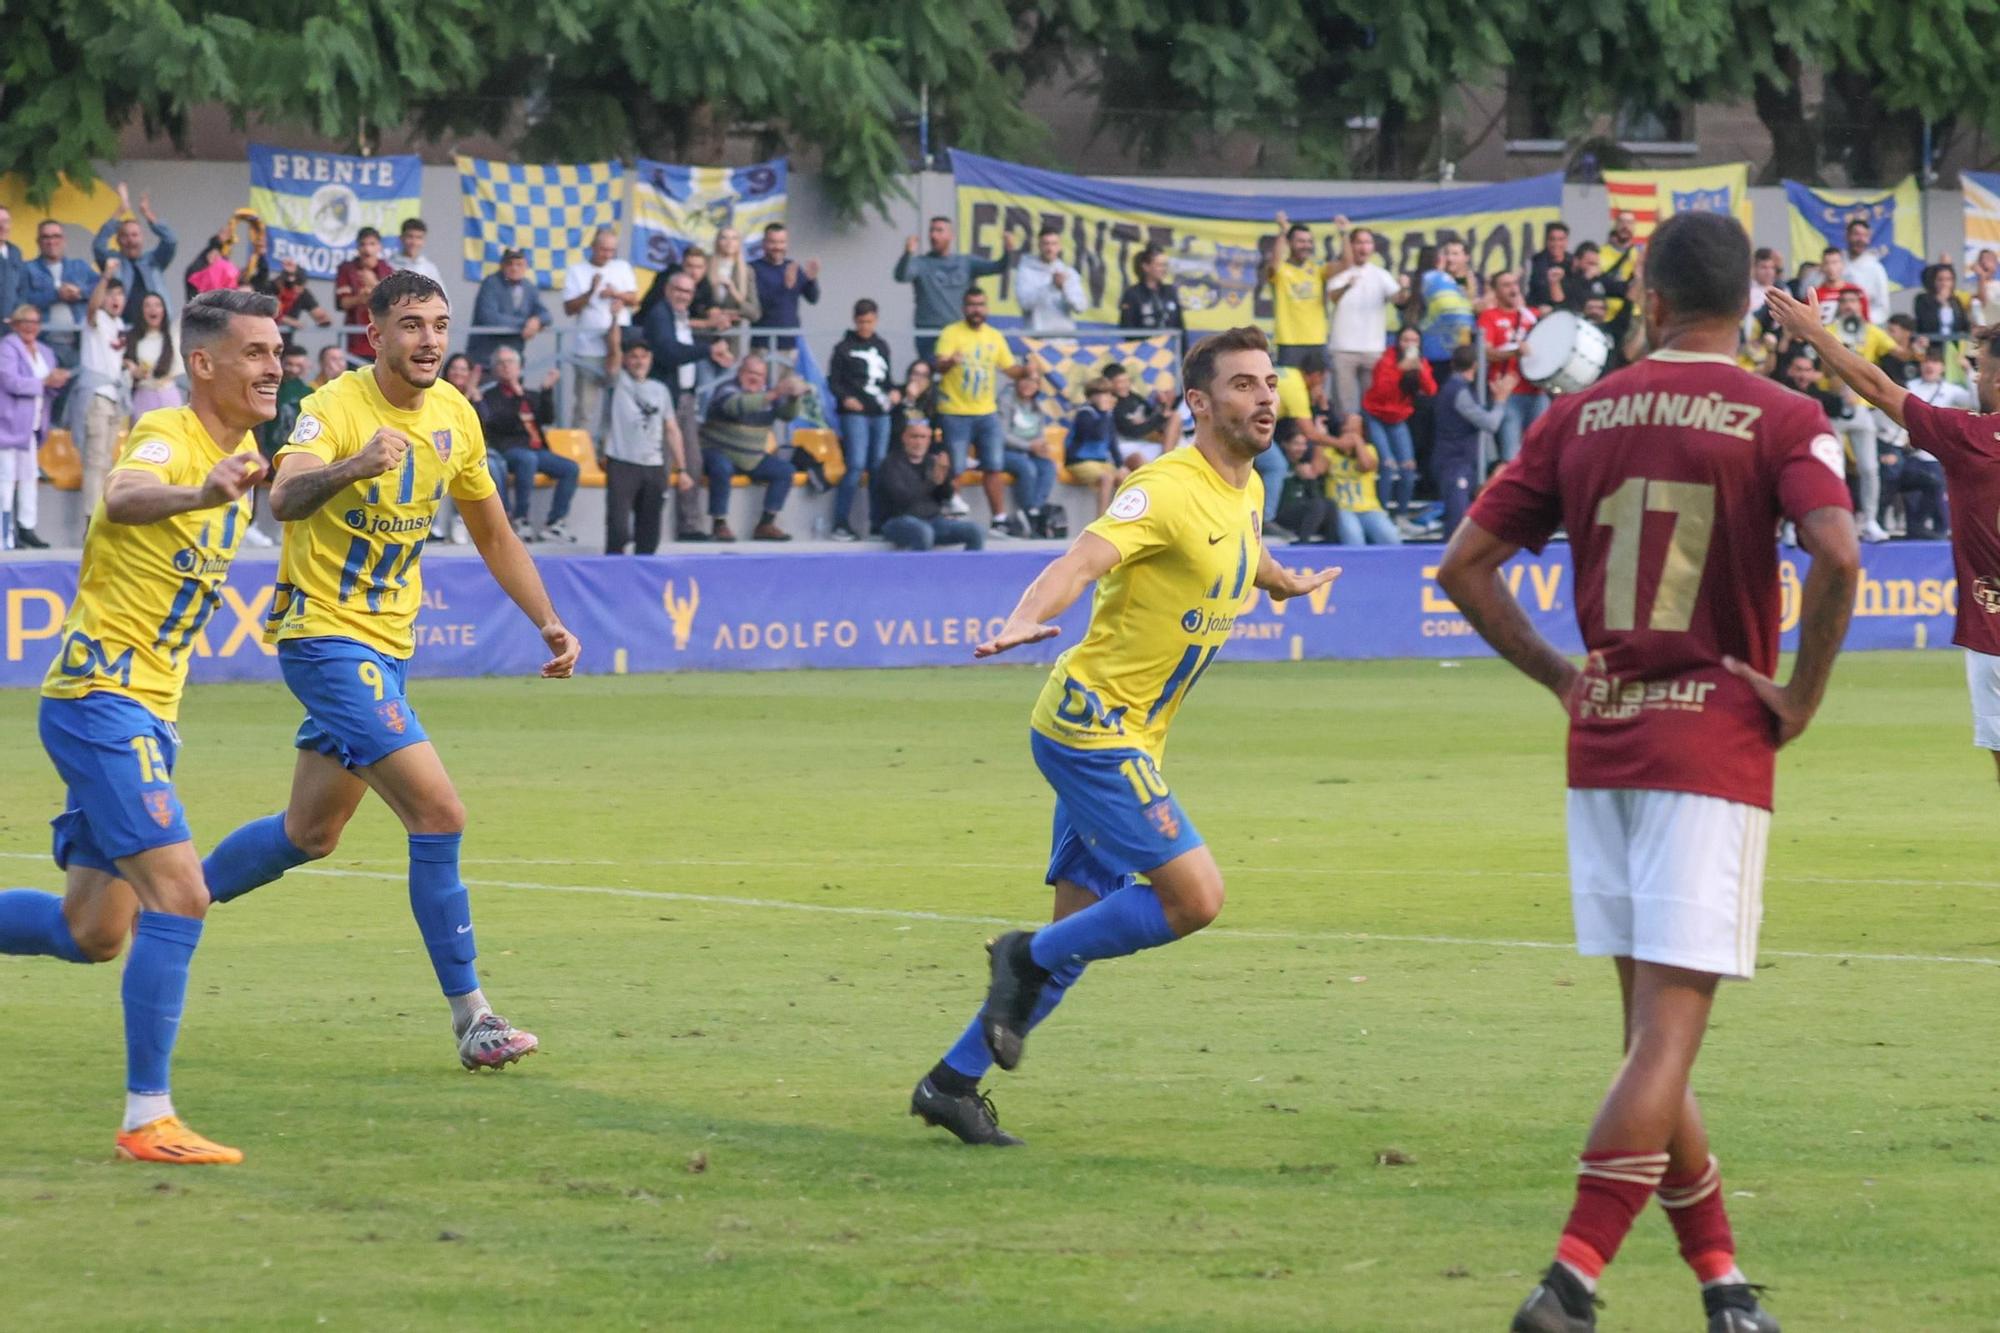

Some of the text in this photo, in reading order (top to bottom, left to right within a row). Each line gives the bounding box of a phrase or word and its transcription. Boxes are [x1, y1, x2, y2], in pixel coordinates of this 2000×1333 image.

[272, 154, 396, 187] FRENTE
[1577, 391, 1763, 442] FRAN NUÑEZ
[366, 514, 433, 535] johnso
[1595, 476, 1717, 633] 17
[1852, 567, 1958, 617] hnso
[415, 623, 477, 646] TATE
[713, 620, 859, 650] ADOLFO
[1202, 612, 1233, 636] john
[1228, 622, 1284, 640] PANY
[357, 660, 384, 702] 9
[129, 735, 171, 784] 15
[1119, 756, 1170, 805] 10
